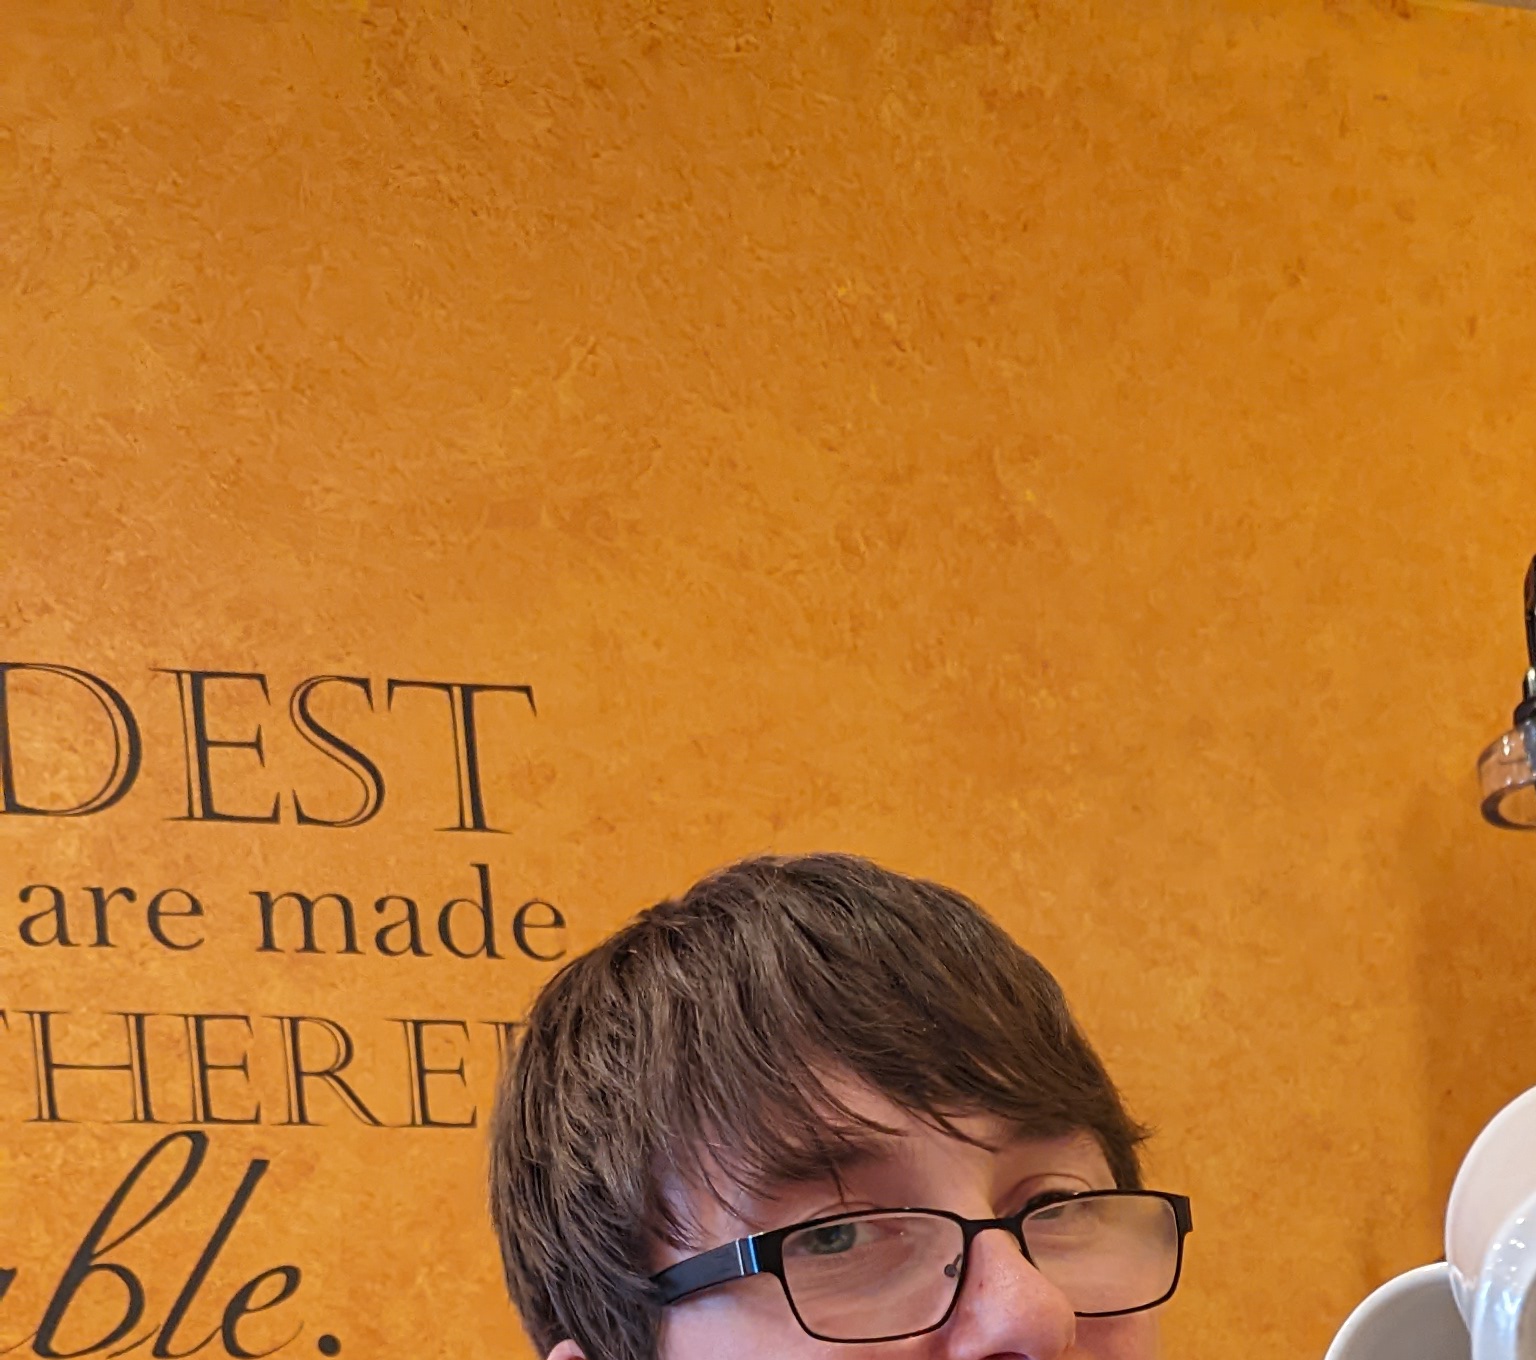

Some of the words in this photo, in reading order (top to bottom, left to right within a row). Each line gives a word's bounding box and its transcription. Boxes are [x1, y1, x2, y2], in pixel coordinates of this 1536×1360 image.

[0, 661, 538, 835] DEST
[17, 883, 206, 951] are
[248, 863, 568, 962] made
[0, 1009, 524, 1128] HERE
[0, 1130, 342, 1360] ble.
